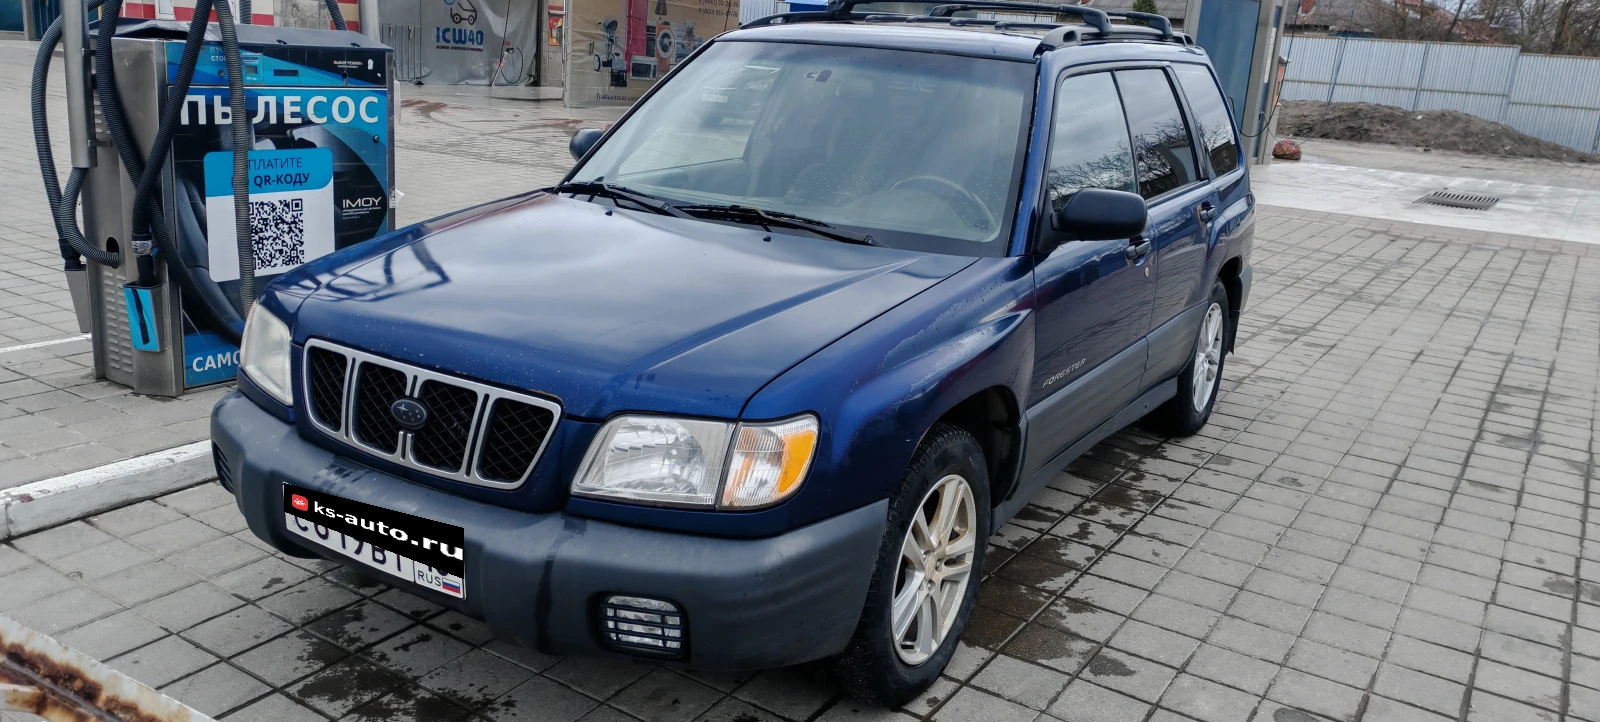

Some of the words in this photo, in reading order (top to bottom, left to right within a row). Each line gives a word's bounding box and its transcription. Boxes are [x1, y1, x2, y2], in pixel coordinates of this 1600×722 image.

[209, 46, 225, 54] ПУС
[247, 157, 303, 170] ПЛАТИТЕ
[253, 172, 310, 188] QR-КОДУ
[342, 196, 382, 209] IMOY
[192, 350, 241, 373] САМО
[1042, 357, 1087, 389] FORESTER
[417, 570, 442, 587] RUS
